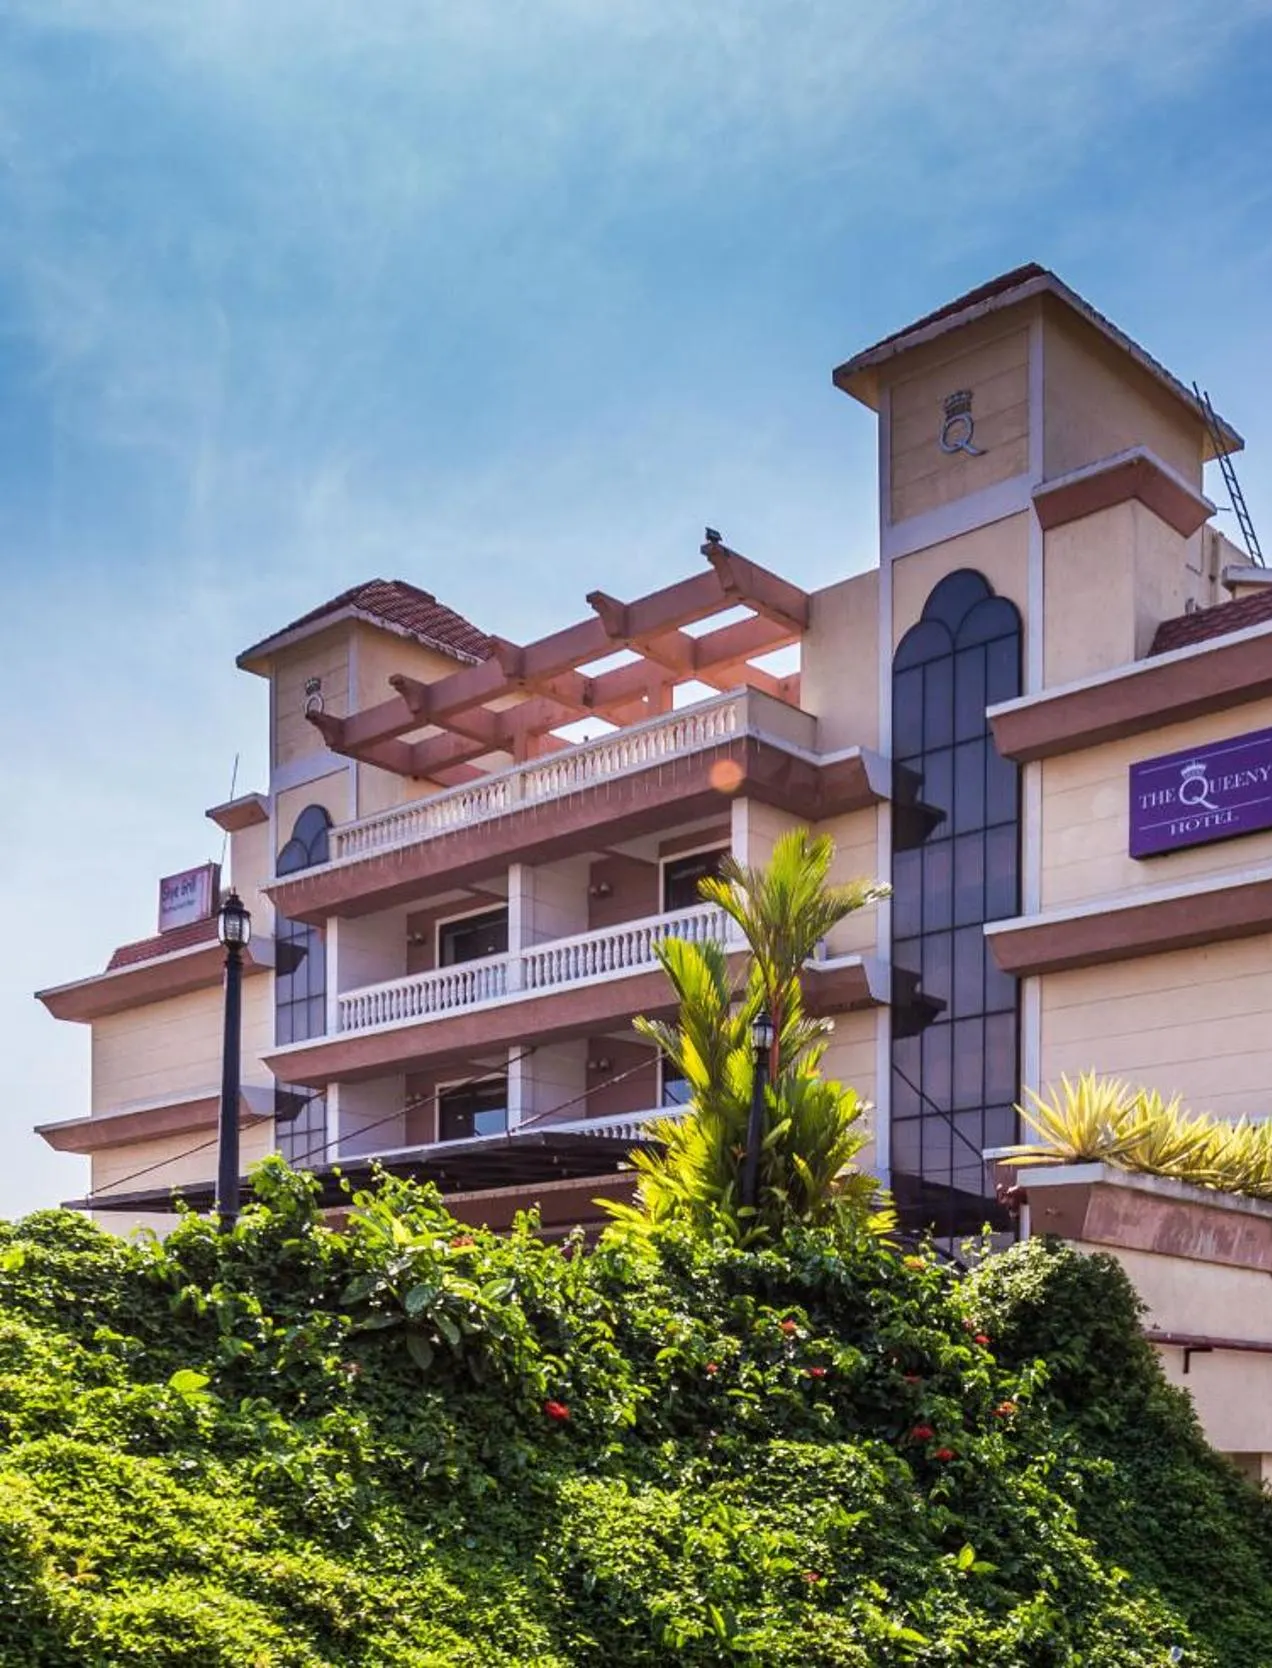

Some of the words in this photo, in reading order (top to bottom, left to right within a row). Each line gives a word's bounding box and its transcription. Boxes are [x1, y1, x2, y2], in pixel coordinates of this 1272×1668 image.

[940, 411, 989, 458] Q
[1139, 788, 1176, 810] THE
[1179, 765, 1272, 809] QUEENY
[1169, 811, 1235, 836] HOTEL
